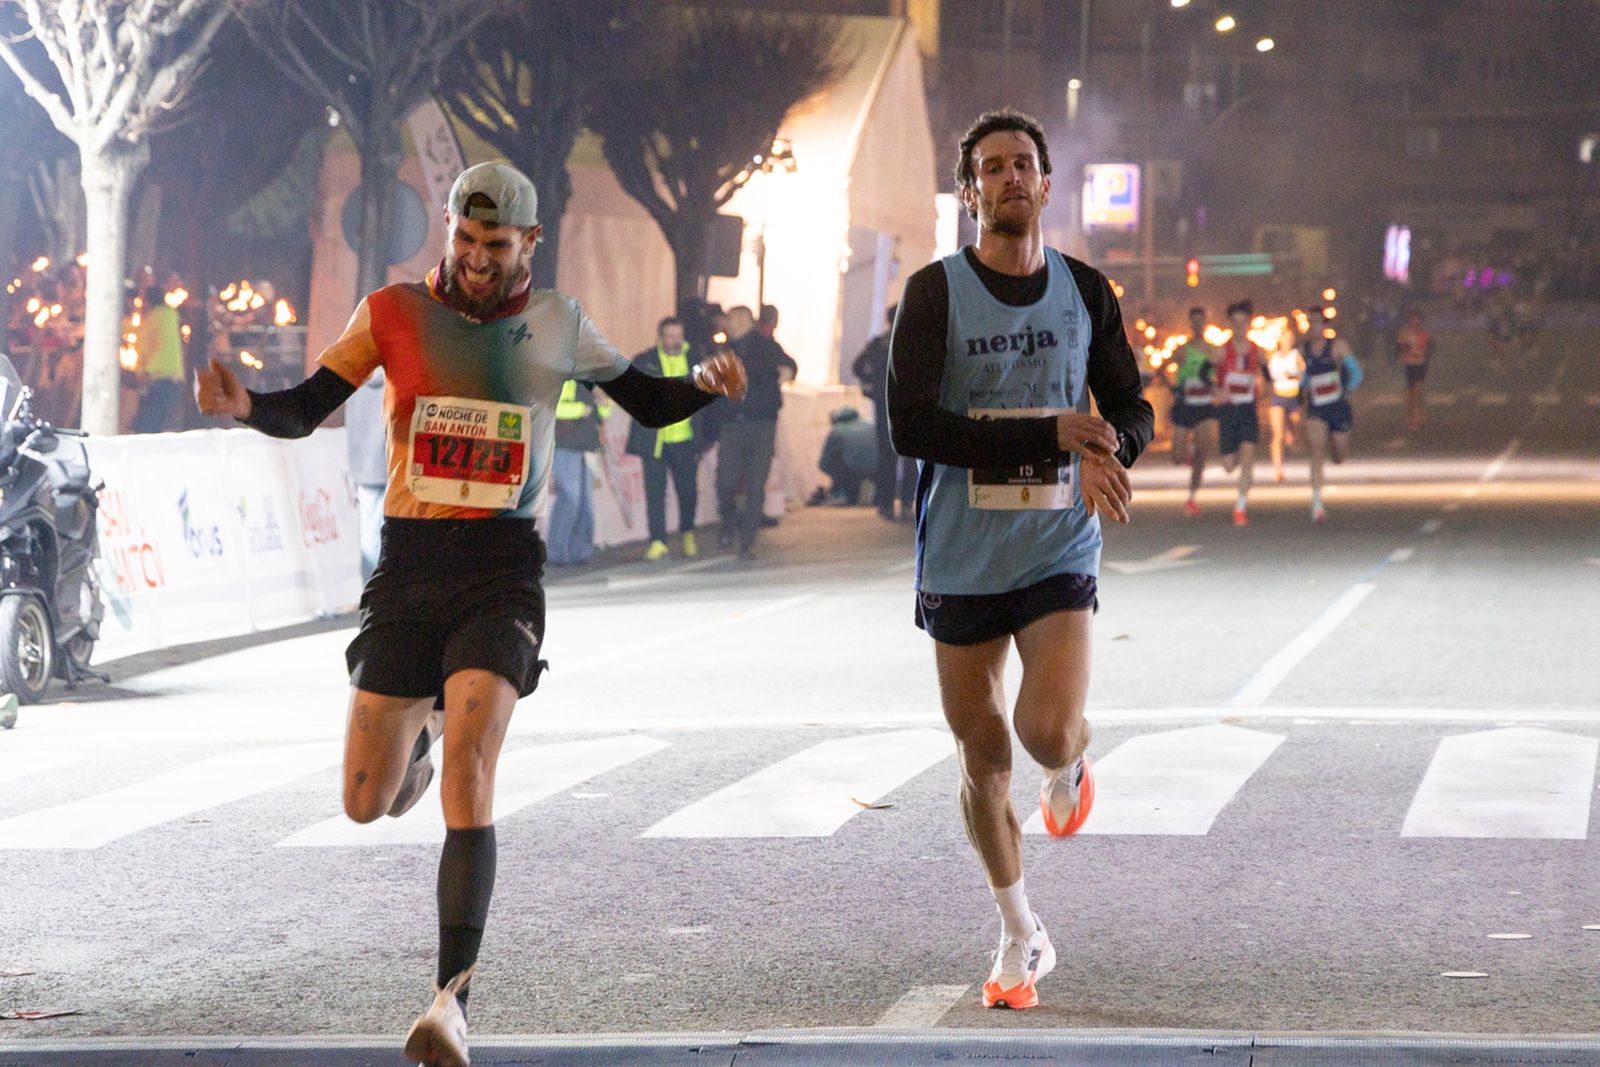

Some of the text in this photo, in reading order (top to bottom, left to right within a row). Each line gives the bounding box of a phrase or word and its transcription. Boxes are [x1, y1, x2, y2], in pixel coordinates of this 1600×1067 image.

[966, 325, 1058, 357] nerja
[438, 409, 472, 421] NOCHE
[474, 413, 488, 424] DE
[424, 421, 447, 432] SAN
[448, 423, 488, 437] ANTÓN
[427, 436, 511, 474] 12725
